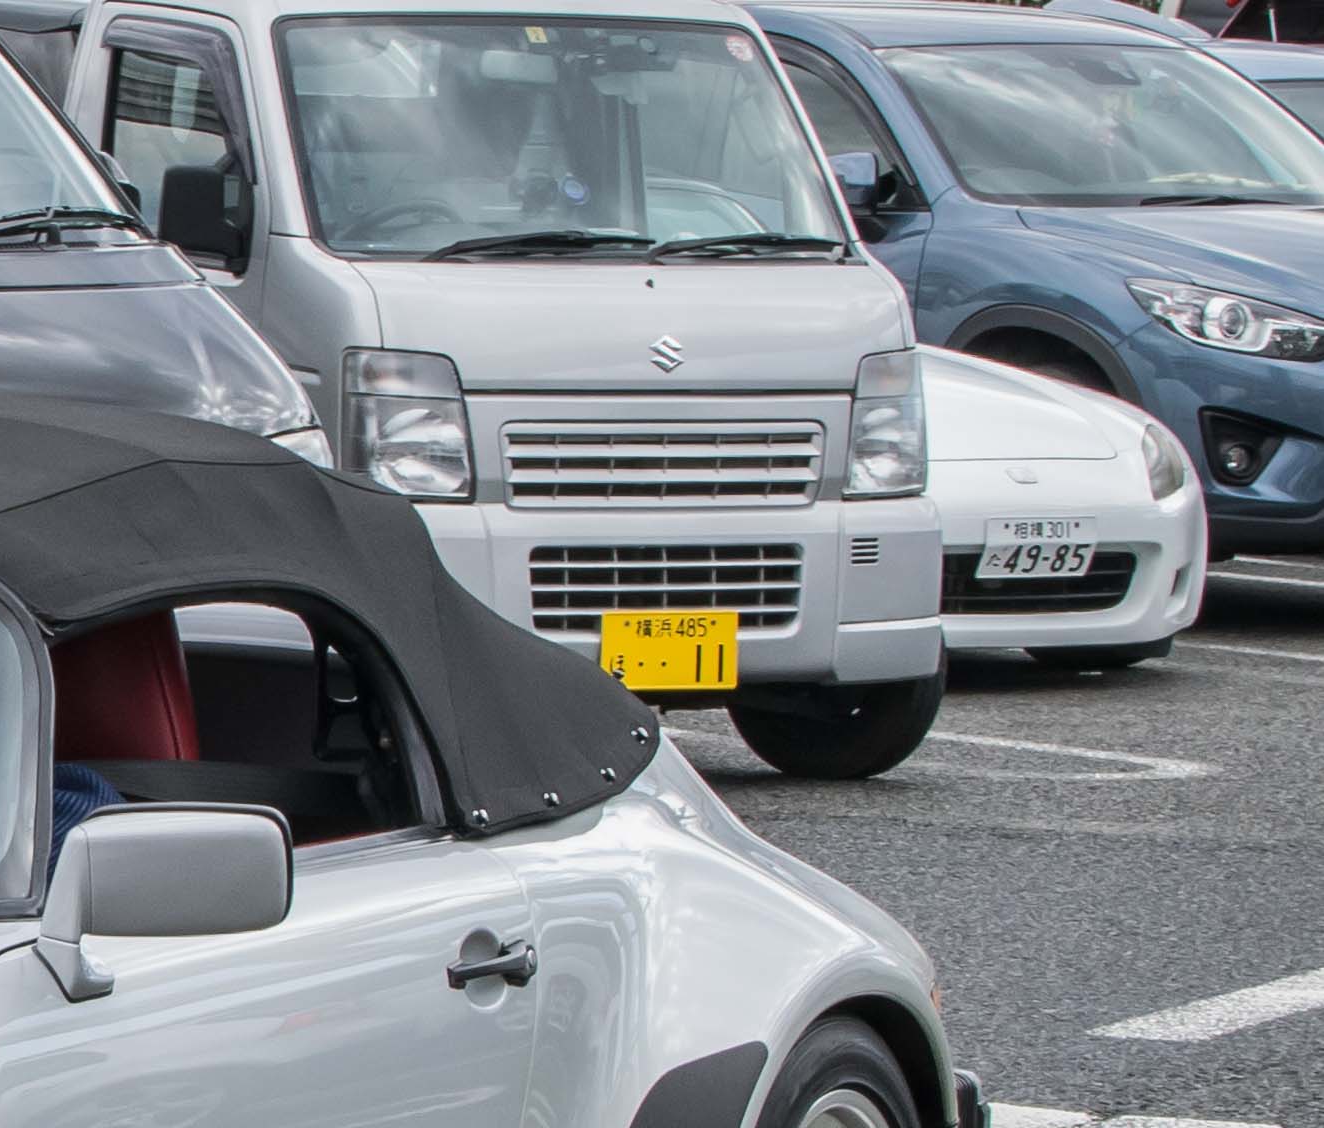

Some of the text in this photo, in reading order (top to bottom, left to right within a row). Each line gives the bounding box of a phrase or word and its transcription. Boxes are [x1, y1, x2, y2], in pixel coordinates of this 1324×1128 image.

[1046, 521, 1070, 538] 301
[1003, 544, 1091, 573] 49-85
[636, 616, 707, 638] 横浜 485
